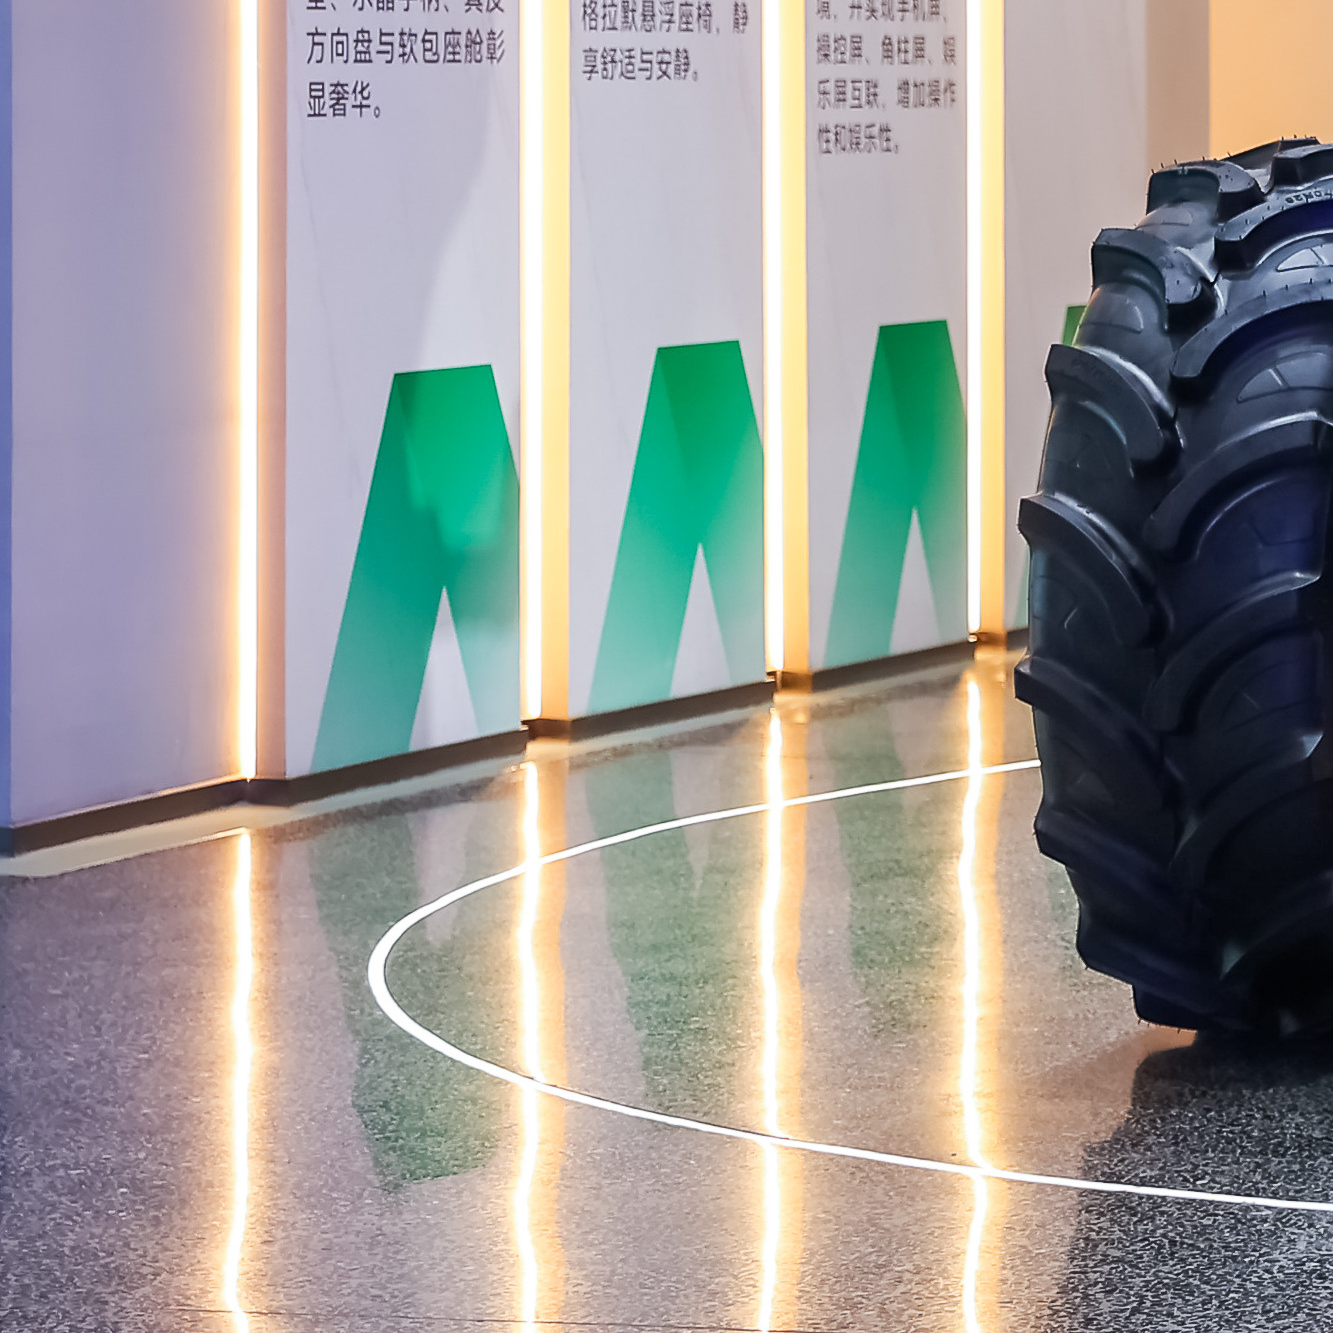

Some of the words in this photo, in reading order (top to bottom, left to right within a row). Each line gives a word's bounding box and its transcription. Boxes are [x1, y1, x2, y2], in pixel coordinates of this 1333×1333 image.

[306, 26, 506, 65] 方向盘与软包座舱彰
[582, 47, 699, 82] 享舒适与安静。
[307, 80, 381, 119] 显奢华。
